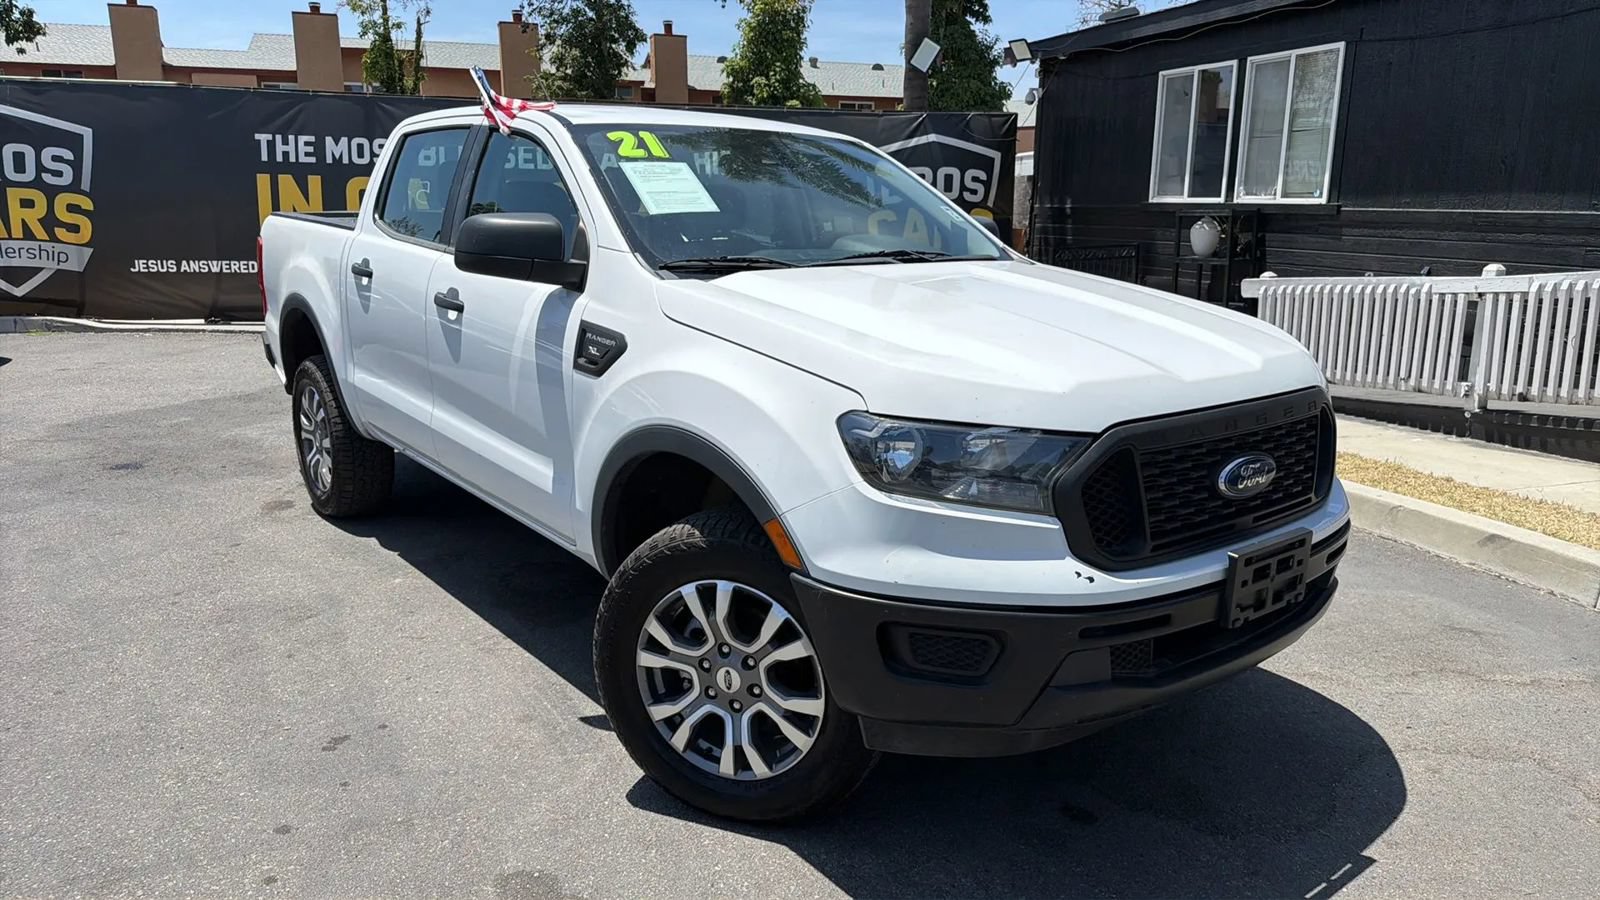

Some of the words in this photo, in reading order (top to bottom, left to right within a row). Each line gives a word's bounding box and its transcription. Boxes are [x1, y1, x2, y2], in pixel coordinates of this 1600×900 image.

[254, 132, 317, 163] THE
[606, 130, 670, 159] 21
[255, 173, 323, 225] IN
[0, 187, 94, 245] RS
[130, 259, 177, 273] JESUS
[180, 260, 258, 274] ANSWERED
[586, 332, 617, 347] RANGER
[1238, 462, 1268, 489] Ford
